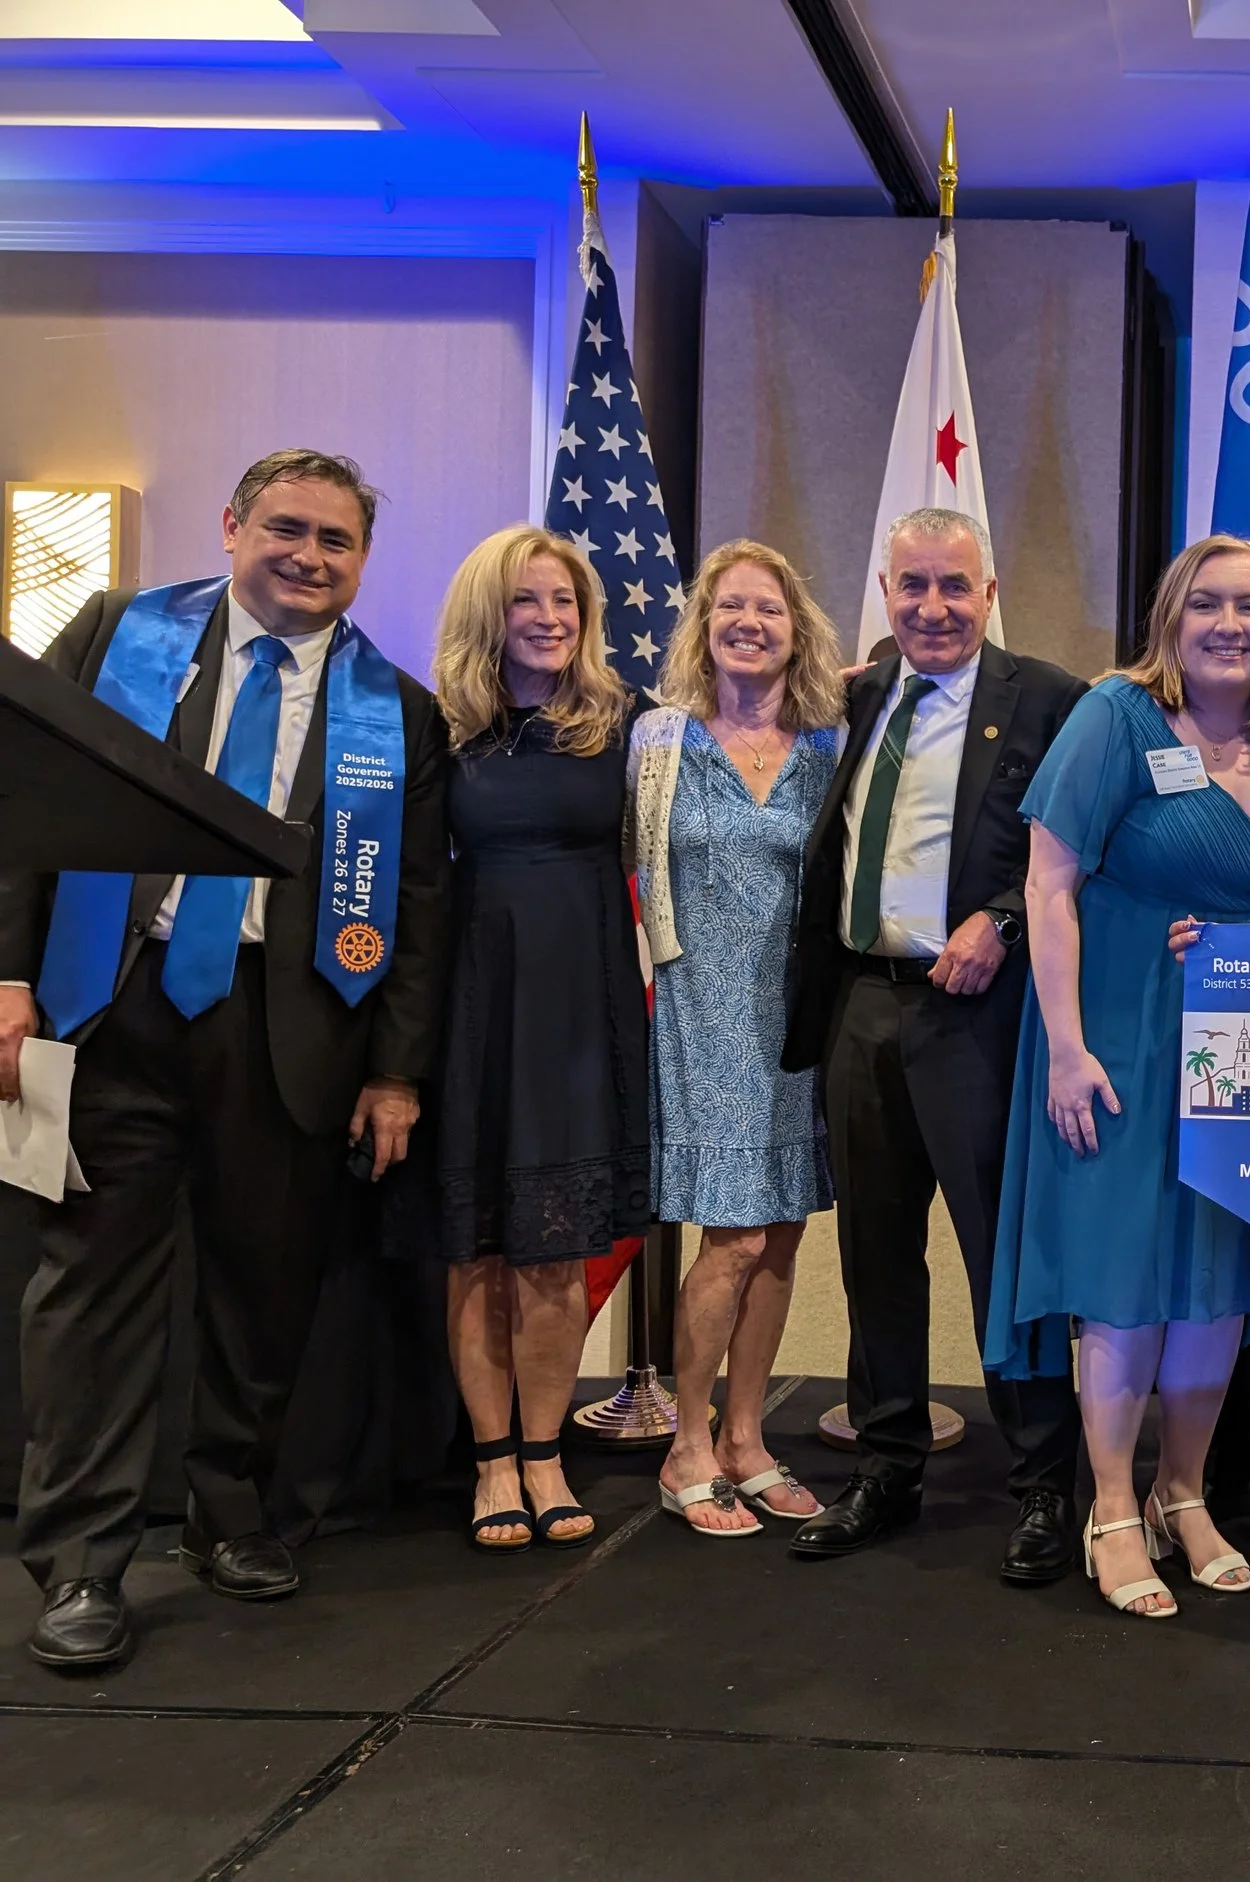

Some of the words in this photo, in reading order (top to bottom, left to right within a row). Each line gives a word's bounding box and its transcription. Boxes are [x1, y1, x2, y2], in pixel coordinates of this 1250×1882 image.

[343, 753, 386, 766] District
[337, 765, 393, 778] Governor
[335, 776, 394, 790] 2025/2026
[336, 810, 351, 855] Zones
[334, 859, 348, 877] 26
[349, 839, 380, 918] Rotary
[333, 882, 347, 893] &
[332, 897, 345, 917] 27
[1203, 978, 1236, 990] District
